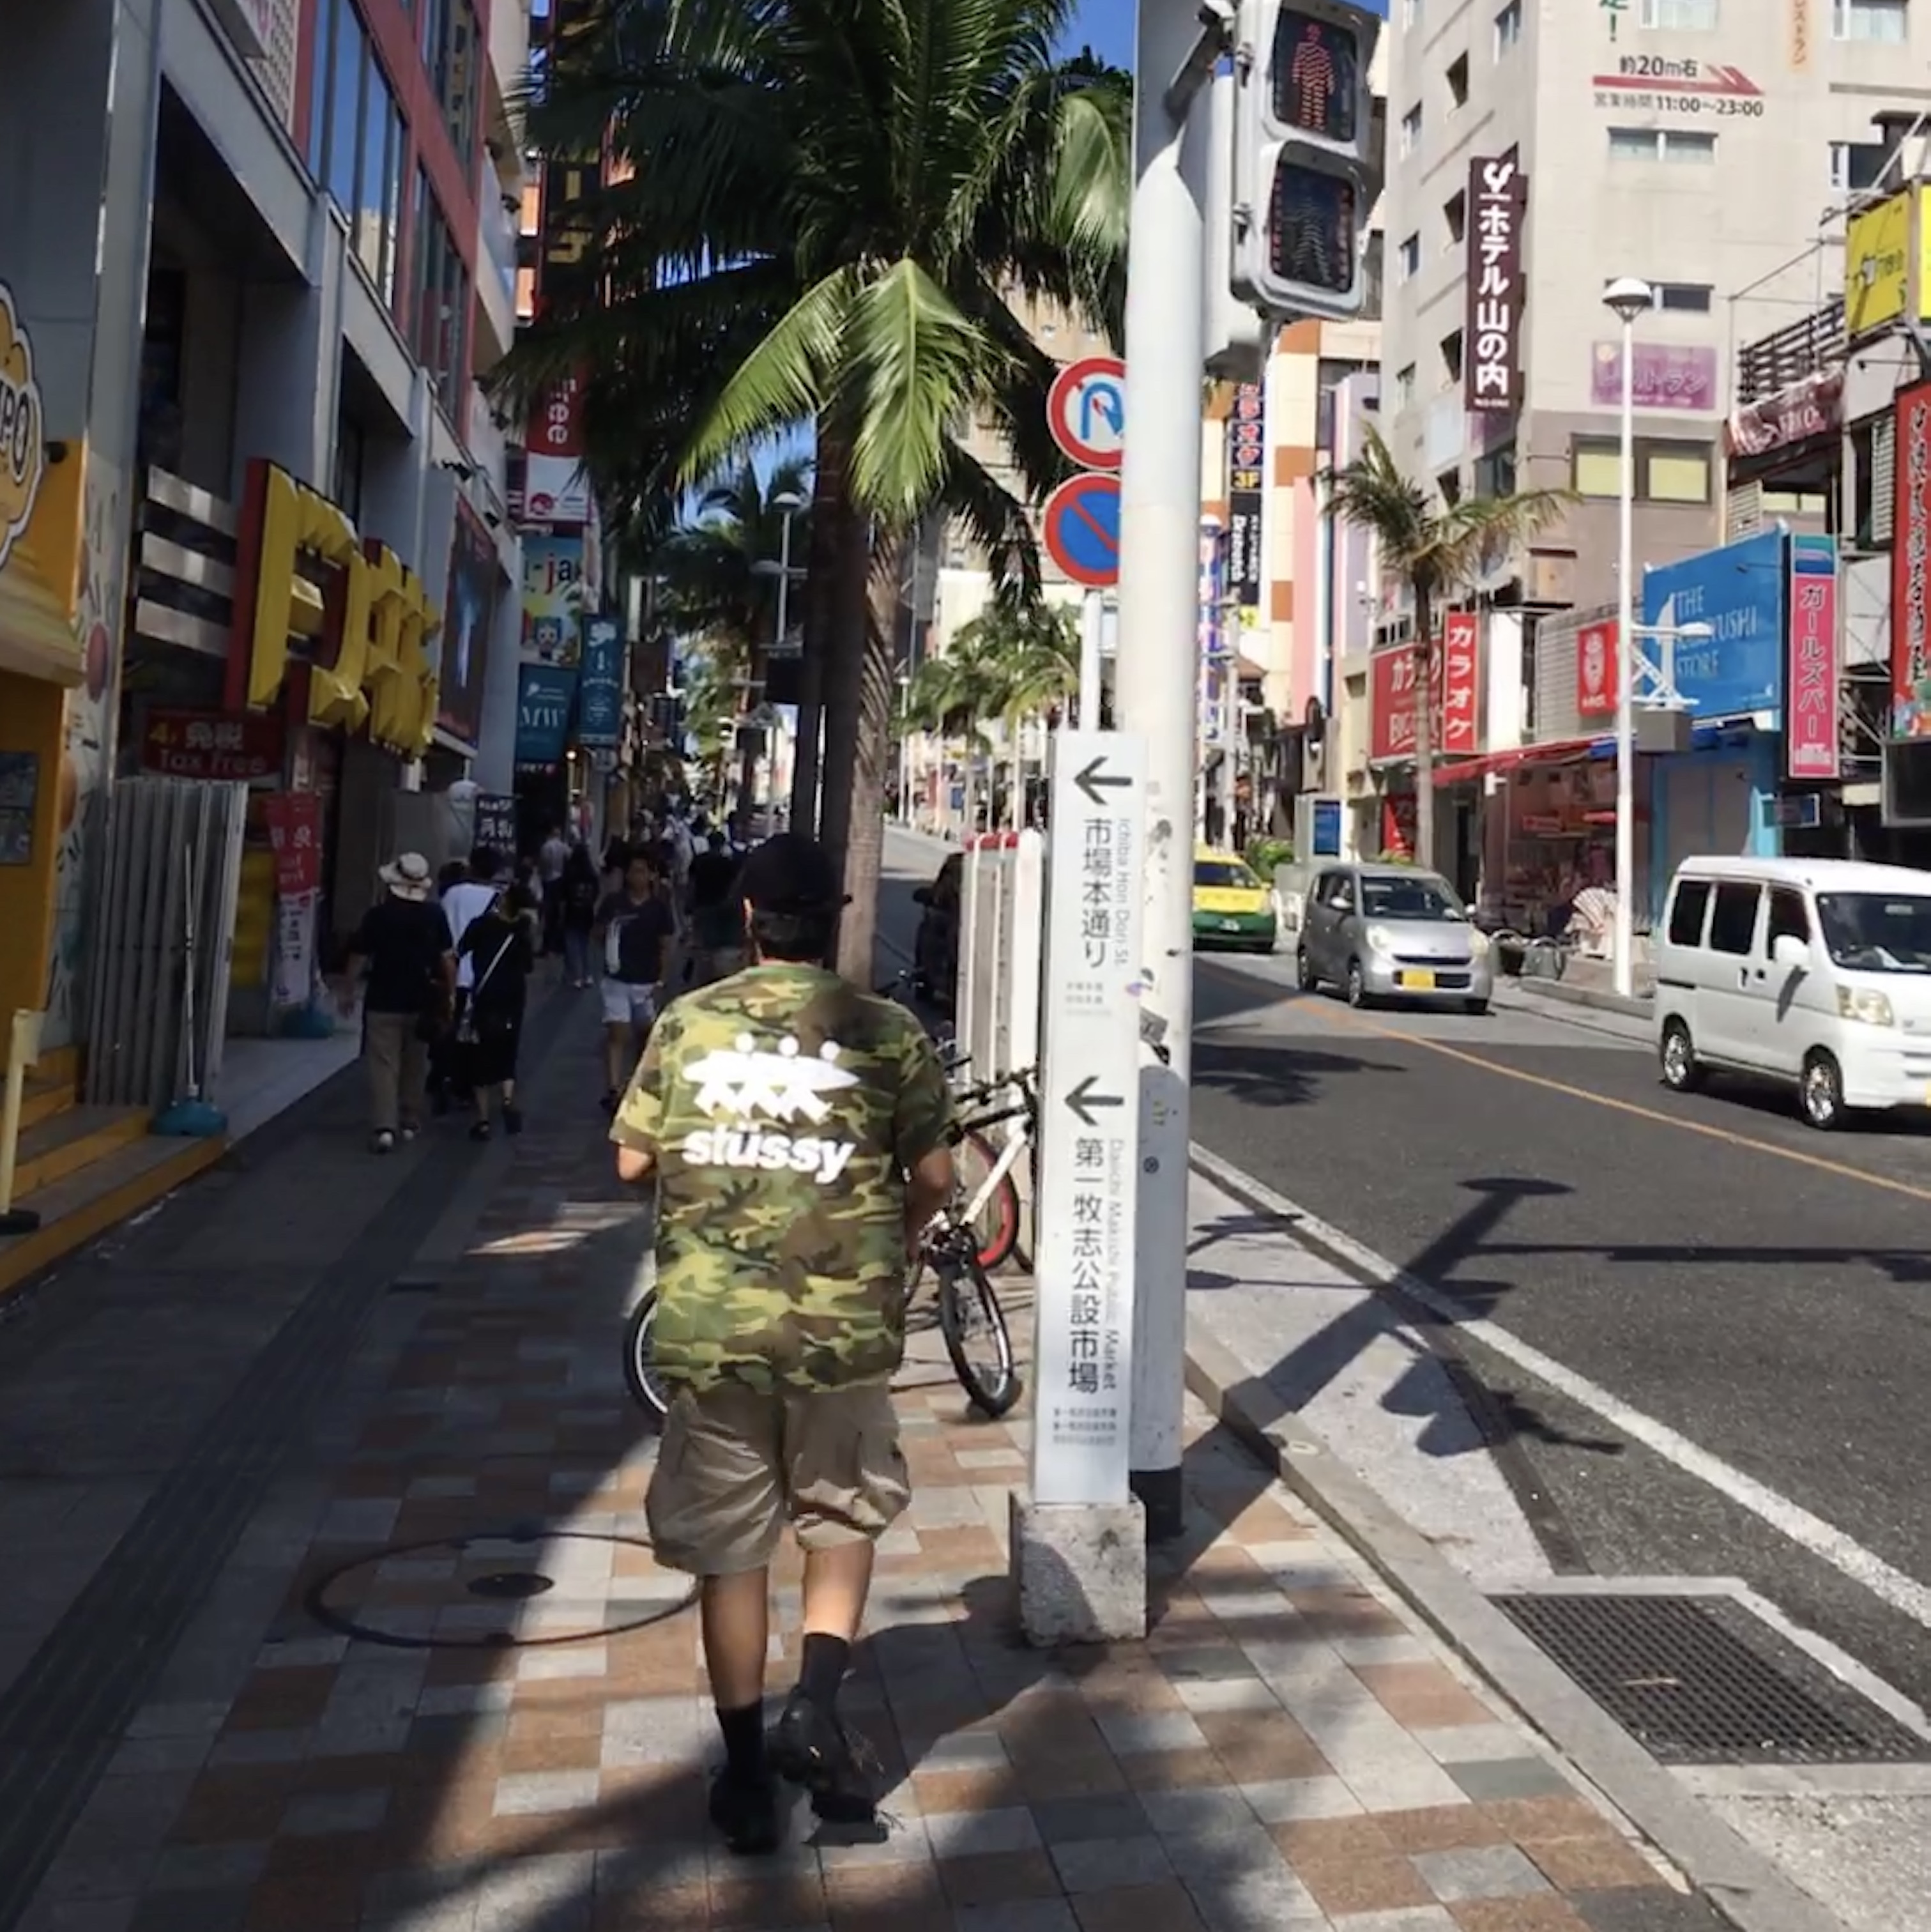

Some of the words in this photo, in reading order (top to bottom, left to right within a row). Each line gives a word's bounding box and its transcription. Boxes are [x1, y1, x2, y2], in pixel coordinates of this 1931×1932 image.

[1619, 56, 1698, 77] 約20m右
[1476, 204, 1511, 395] ホテル山の内
[1676, 585, 1705, 620] THE
[1391, 646, 1442, 693] カラケ
[1447, 625, 1473, 740] カラオケ
[1799, 584, 1827, 739] ガールズバー
[160, 748, 203, 770] Tax
[185, 721, 244, 750] 免税
[1118, 818, 1131, 867] Ichiba
[1083, 817, 1113, 968] 市場本通り
[1117, 871, 1130, 904] Hon
[1069, 1137, 1104, 1394] 第一牧志公設市場
[1103, 1328, 1120, 1392] Market
